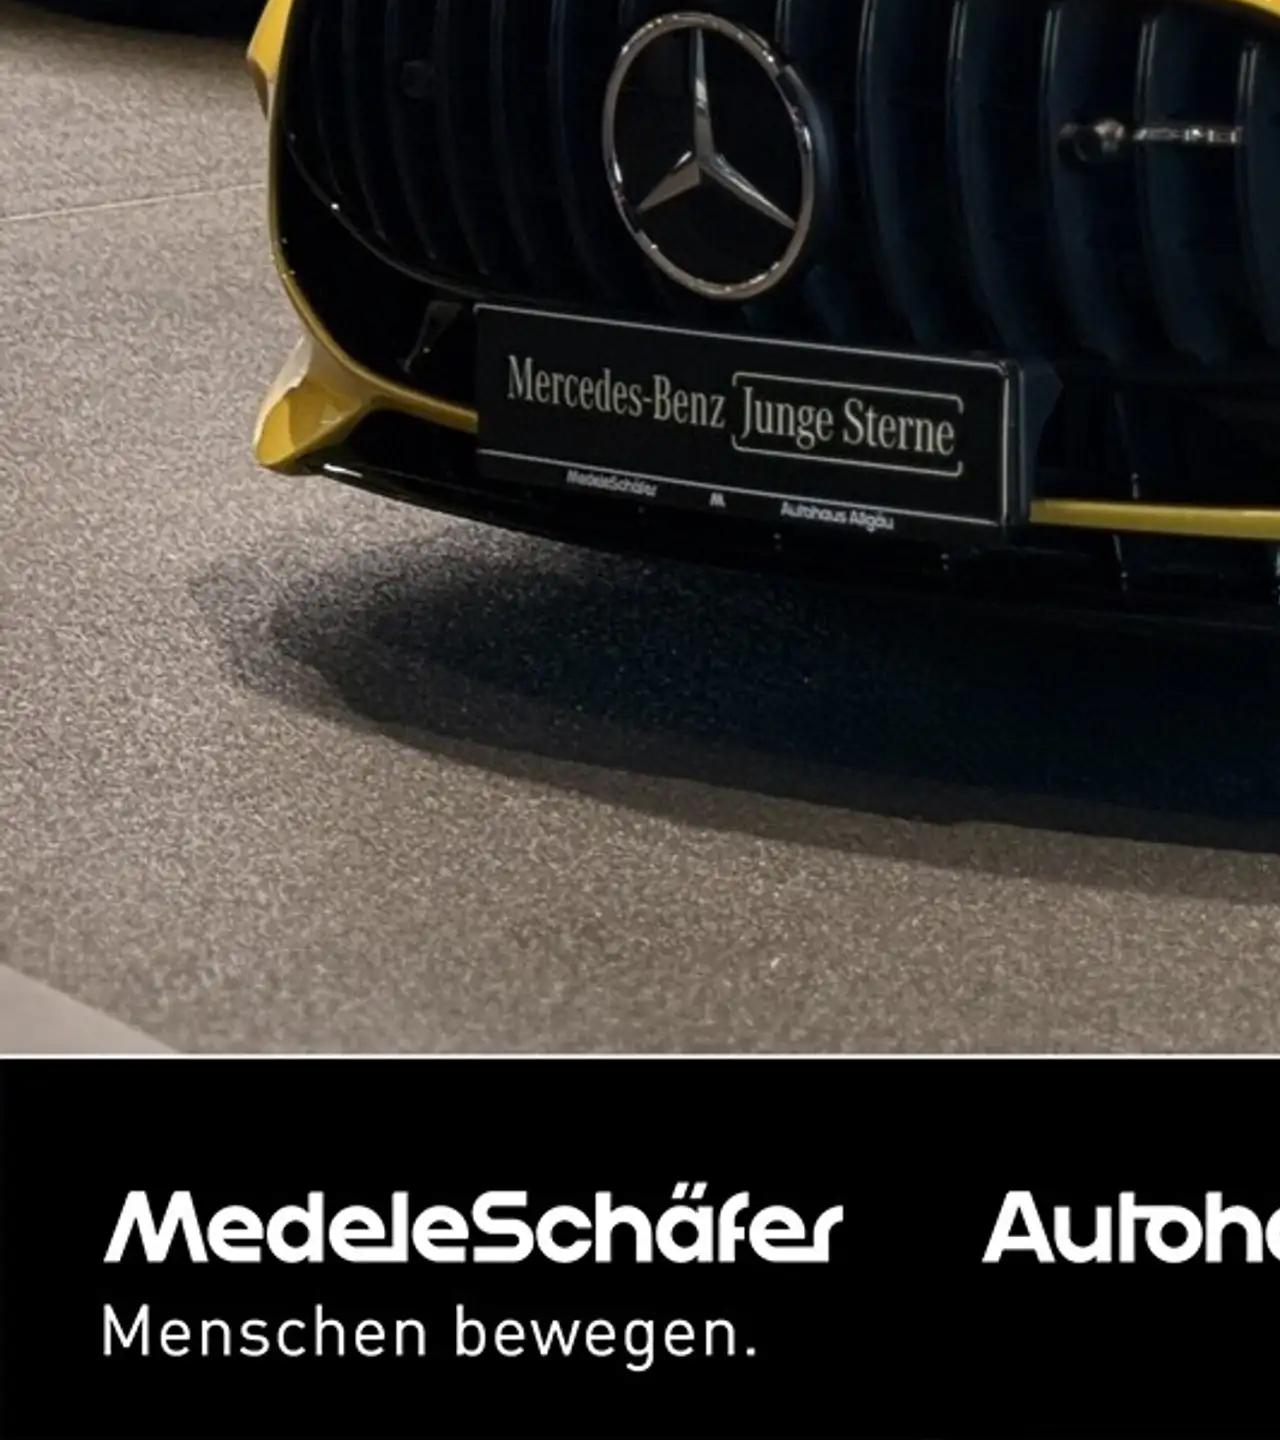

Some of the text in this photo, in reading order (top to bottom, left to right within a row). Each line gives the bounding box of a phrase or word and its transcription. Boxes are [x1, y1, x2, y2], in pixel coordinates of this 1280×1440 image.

[507, 354, 955, 456] Mercedes-Benz Junge Sterne
